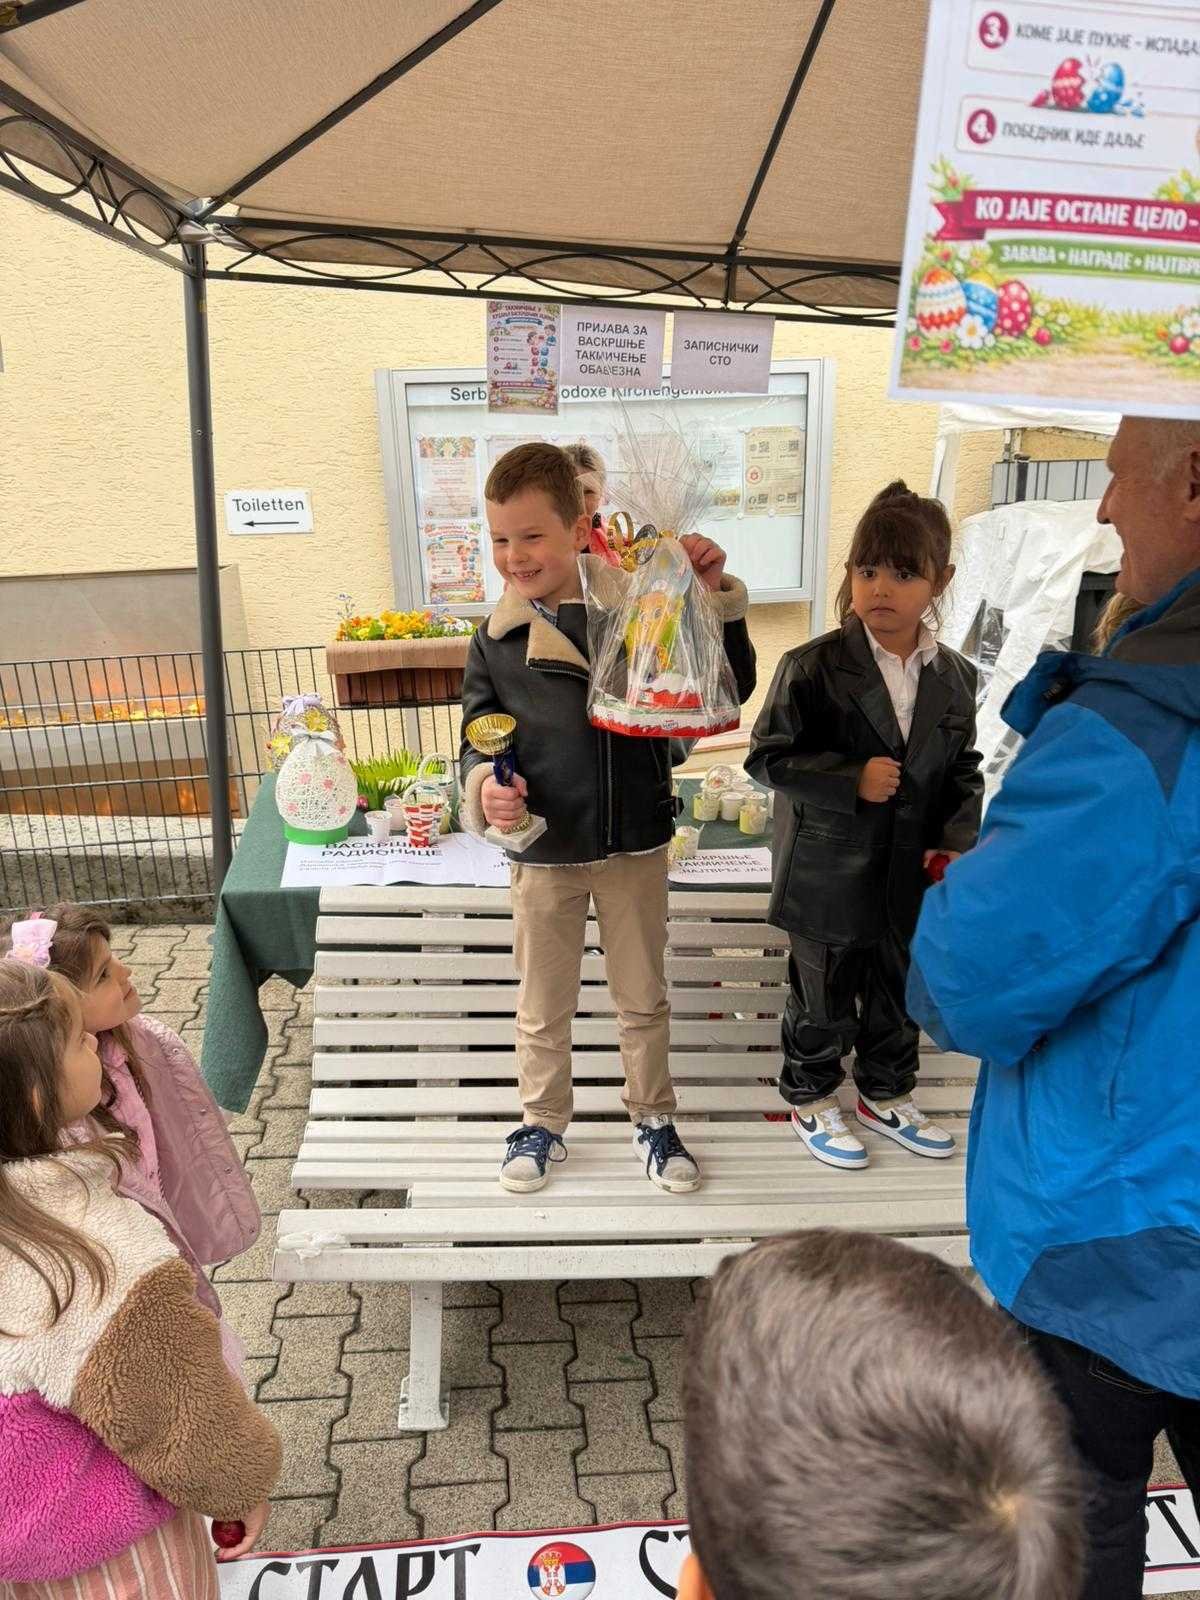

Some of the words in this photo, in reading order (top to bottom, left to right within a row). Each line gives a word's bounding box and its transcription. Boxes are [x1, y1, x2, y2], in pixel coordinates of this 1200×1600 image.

[1016, 23, 1055, 41] КОМЕ
[1056, 28, 1083, 45] ЈАЈЕ
[1088, 31, 1132, 48] ПУКНЕ
[1003, 121, 1071, 143] ПОБЕДНИК
[1075, 130, 1101, 146] ИДЕ
[1103, 131, 1145, 149] ДАЉЕ
[976, 197, 1004, 221] КО
[1006, 198, 1052, 223] ЈАЈЕ
[1055, 201, 1132, 227] ОСТАНЕ
[1133, 206, 1188, 232] ЦЕЛО
[1000, 245, 1056, 264] ЗАБАВА
[1068, 249, 1134, 271] НАГРАДЕ
[577, 321, 630, 336] ПРИЈАВА
[633, 325, 648, 337] ЗА
[578, 336, 646, 350] ВАСКРШЊЕ
[684, 340, 759, 354] ЗАПИСНИЧКИ
[576, 350, 647, 364] ТАКМИЧЕЊЕ
[709, 354, 732, 366] СТО
[579, 365, 642, 378] ОБАВЕЗНА
[232, 498, 304, 512] Toiletten
[321, 848, 442, 858] РАДИОНИЦЕ
